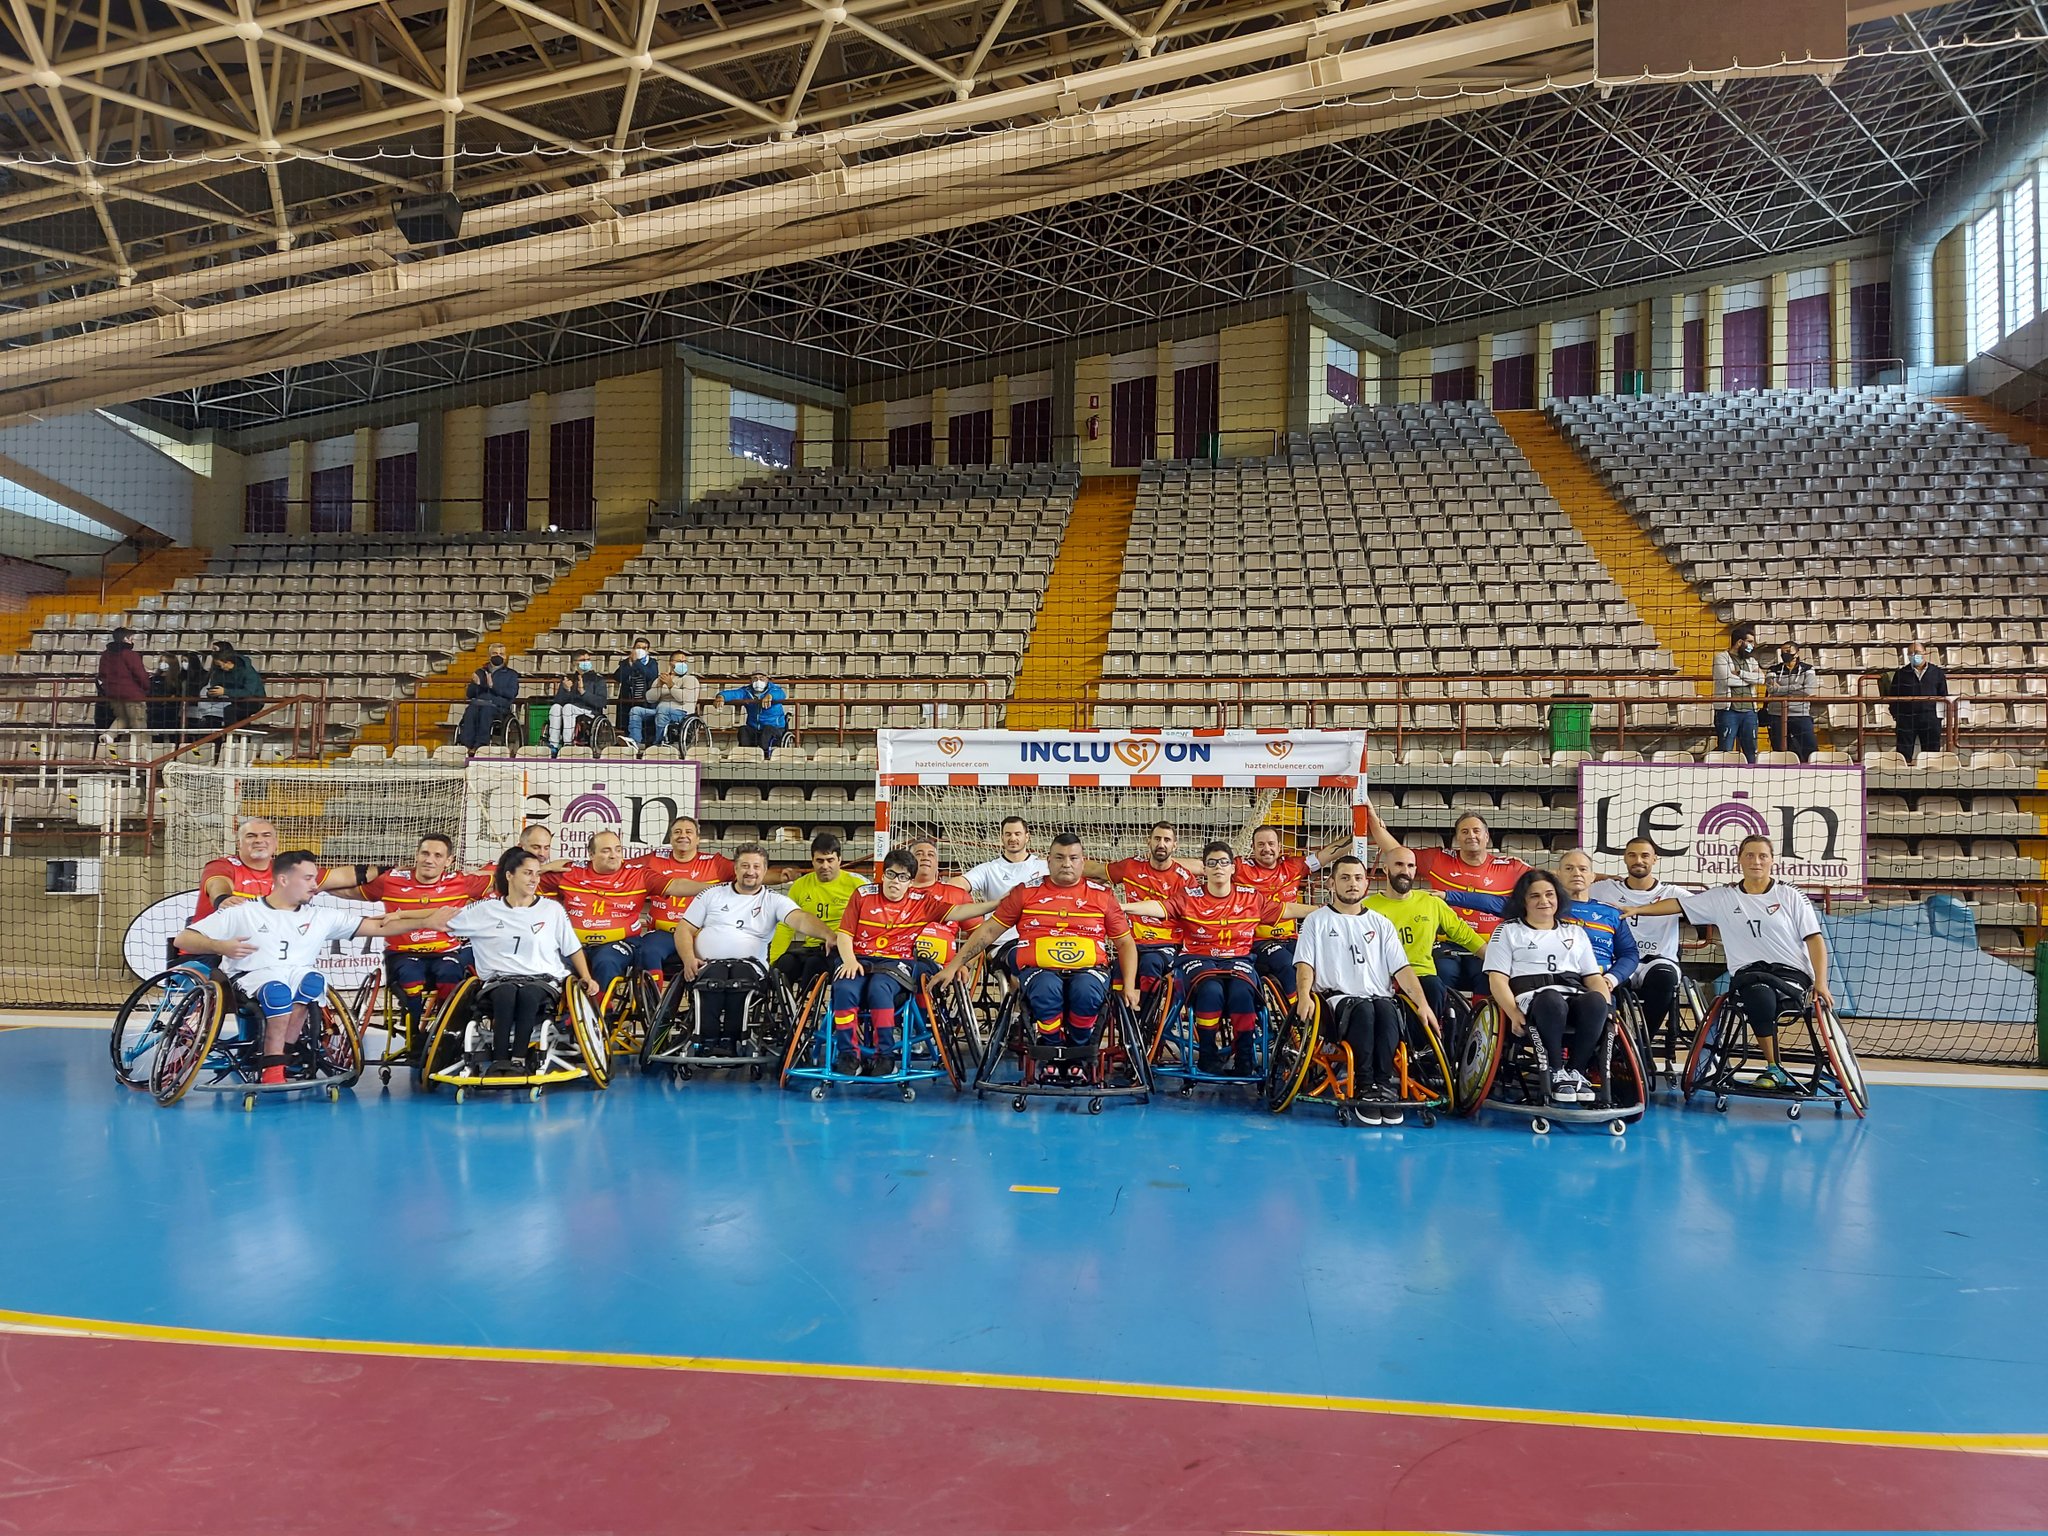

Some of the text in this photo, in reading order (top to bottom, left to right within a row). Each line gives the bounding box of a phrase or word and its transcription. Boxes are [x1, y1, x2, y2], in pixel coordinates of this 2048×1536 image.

[915, 760, 990, 768] hazteincluencer.com
[1244, 761, 1325, 770] hazteincluencer.com
[1696, 840, 1739, 857] Cuna
[1696, 856, 1849, 877] Parlantarismo
[592, 899, 605, 916] 14
[816, 902, 829, 919] 91
[1398, 926, 1414, 945] 16
[1746, 919, 1762, 938] 17
[512, 936, 521, 955] 7
[1217, 929, 1232, 947] 11
[1637, 940, 1658, 950] GOS
[278, 940, 289, 960] 3
[1546, 954, 1557, 972] 6
